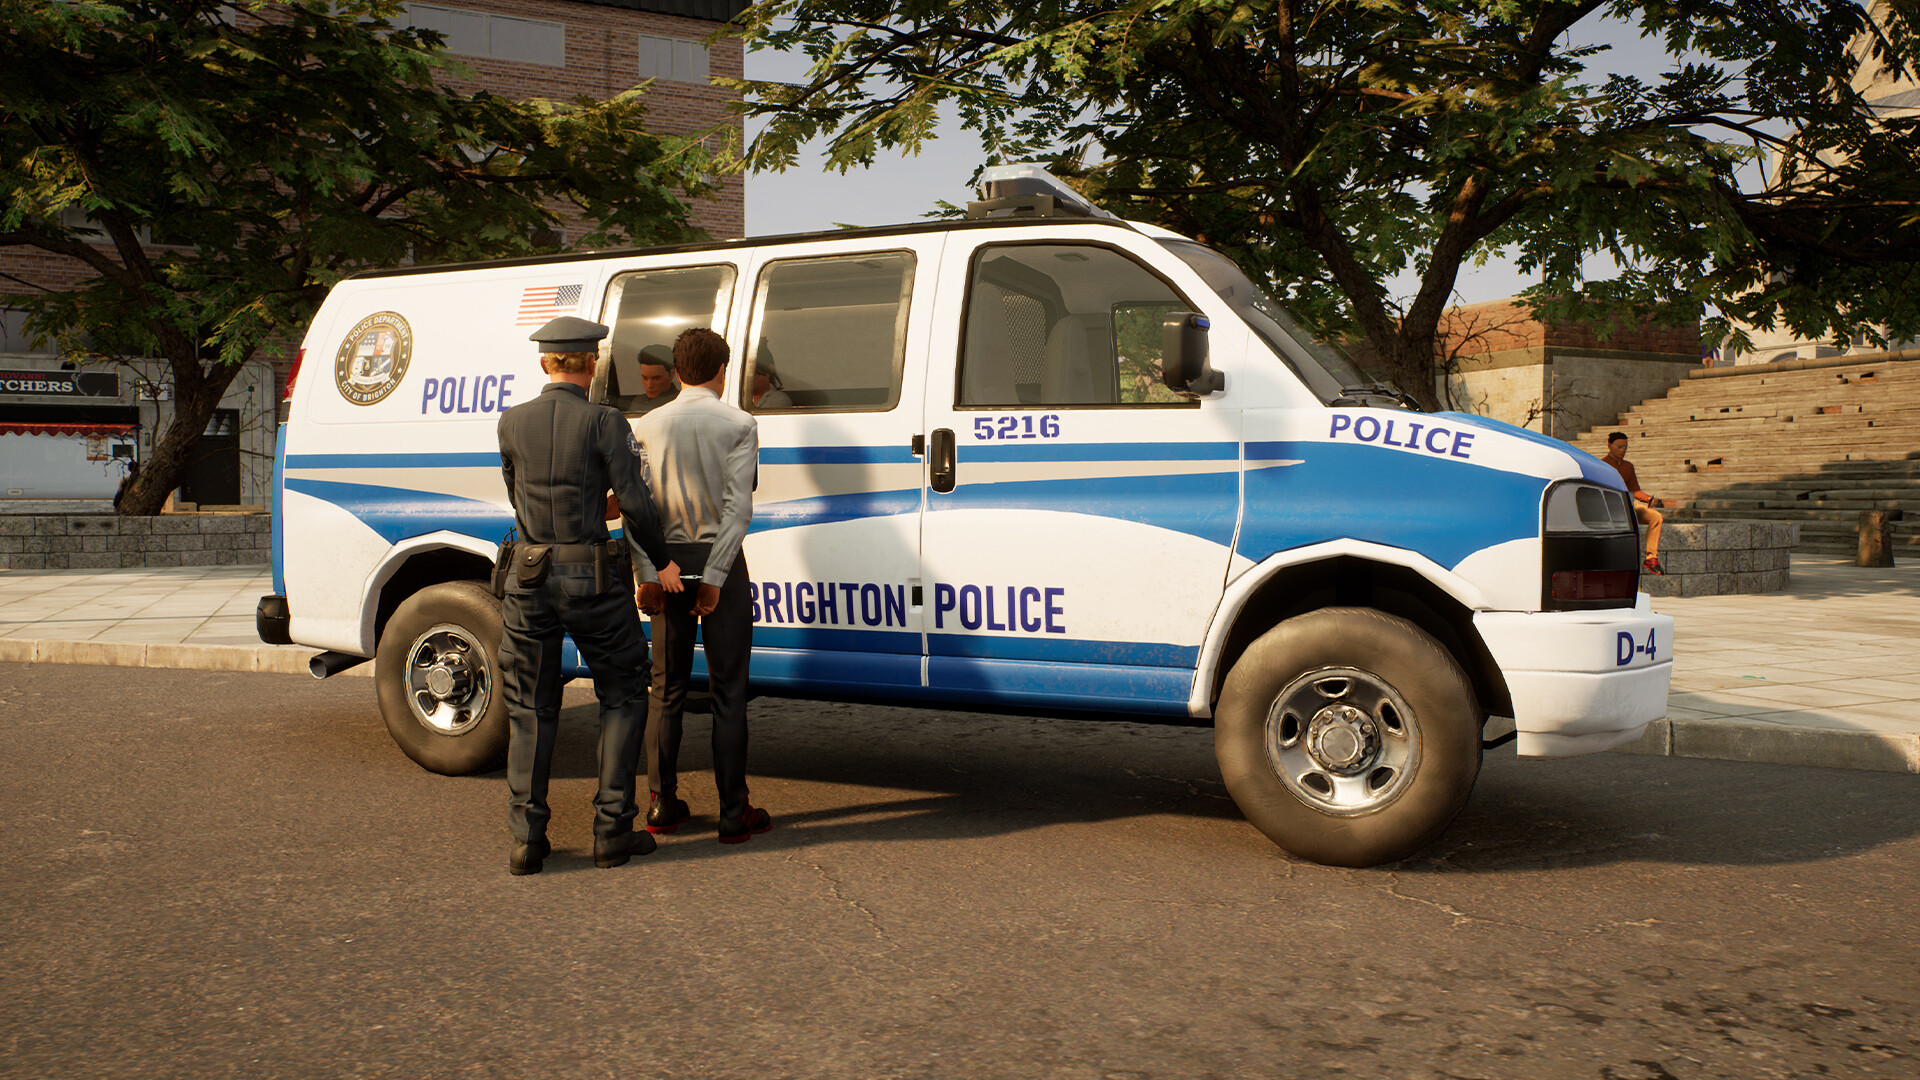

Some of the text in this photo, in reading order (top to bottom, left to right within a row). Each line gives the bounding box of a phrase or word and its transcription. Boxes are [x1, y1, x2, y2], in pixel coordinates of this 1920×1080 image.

[349, 315, 409, 342] POLICE DEPARTMENT
[341, 378, 396, 402] CITY OF BRIGHTON
[421, 374, 515, 415] POLICE
[974, 414, 1060, 440] 5216
[1329, 414, 1475, 459] POLICE
[750, 581, 1066, 633] BRIGHTON POLICE
[1616, 627, 1657, 666] D-4
